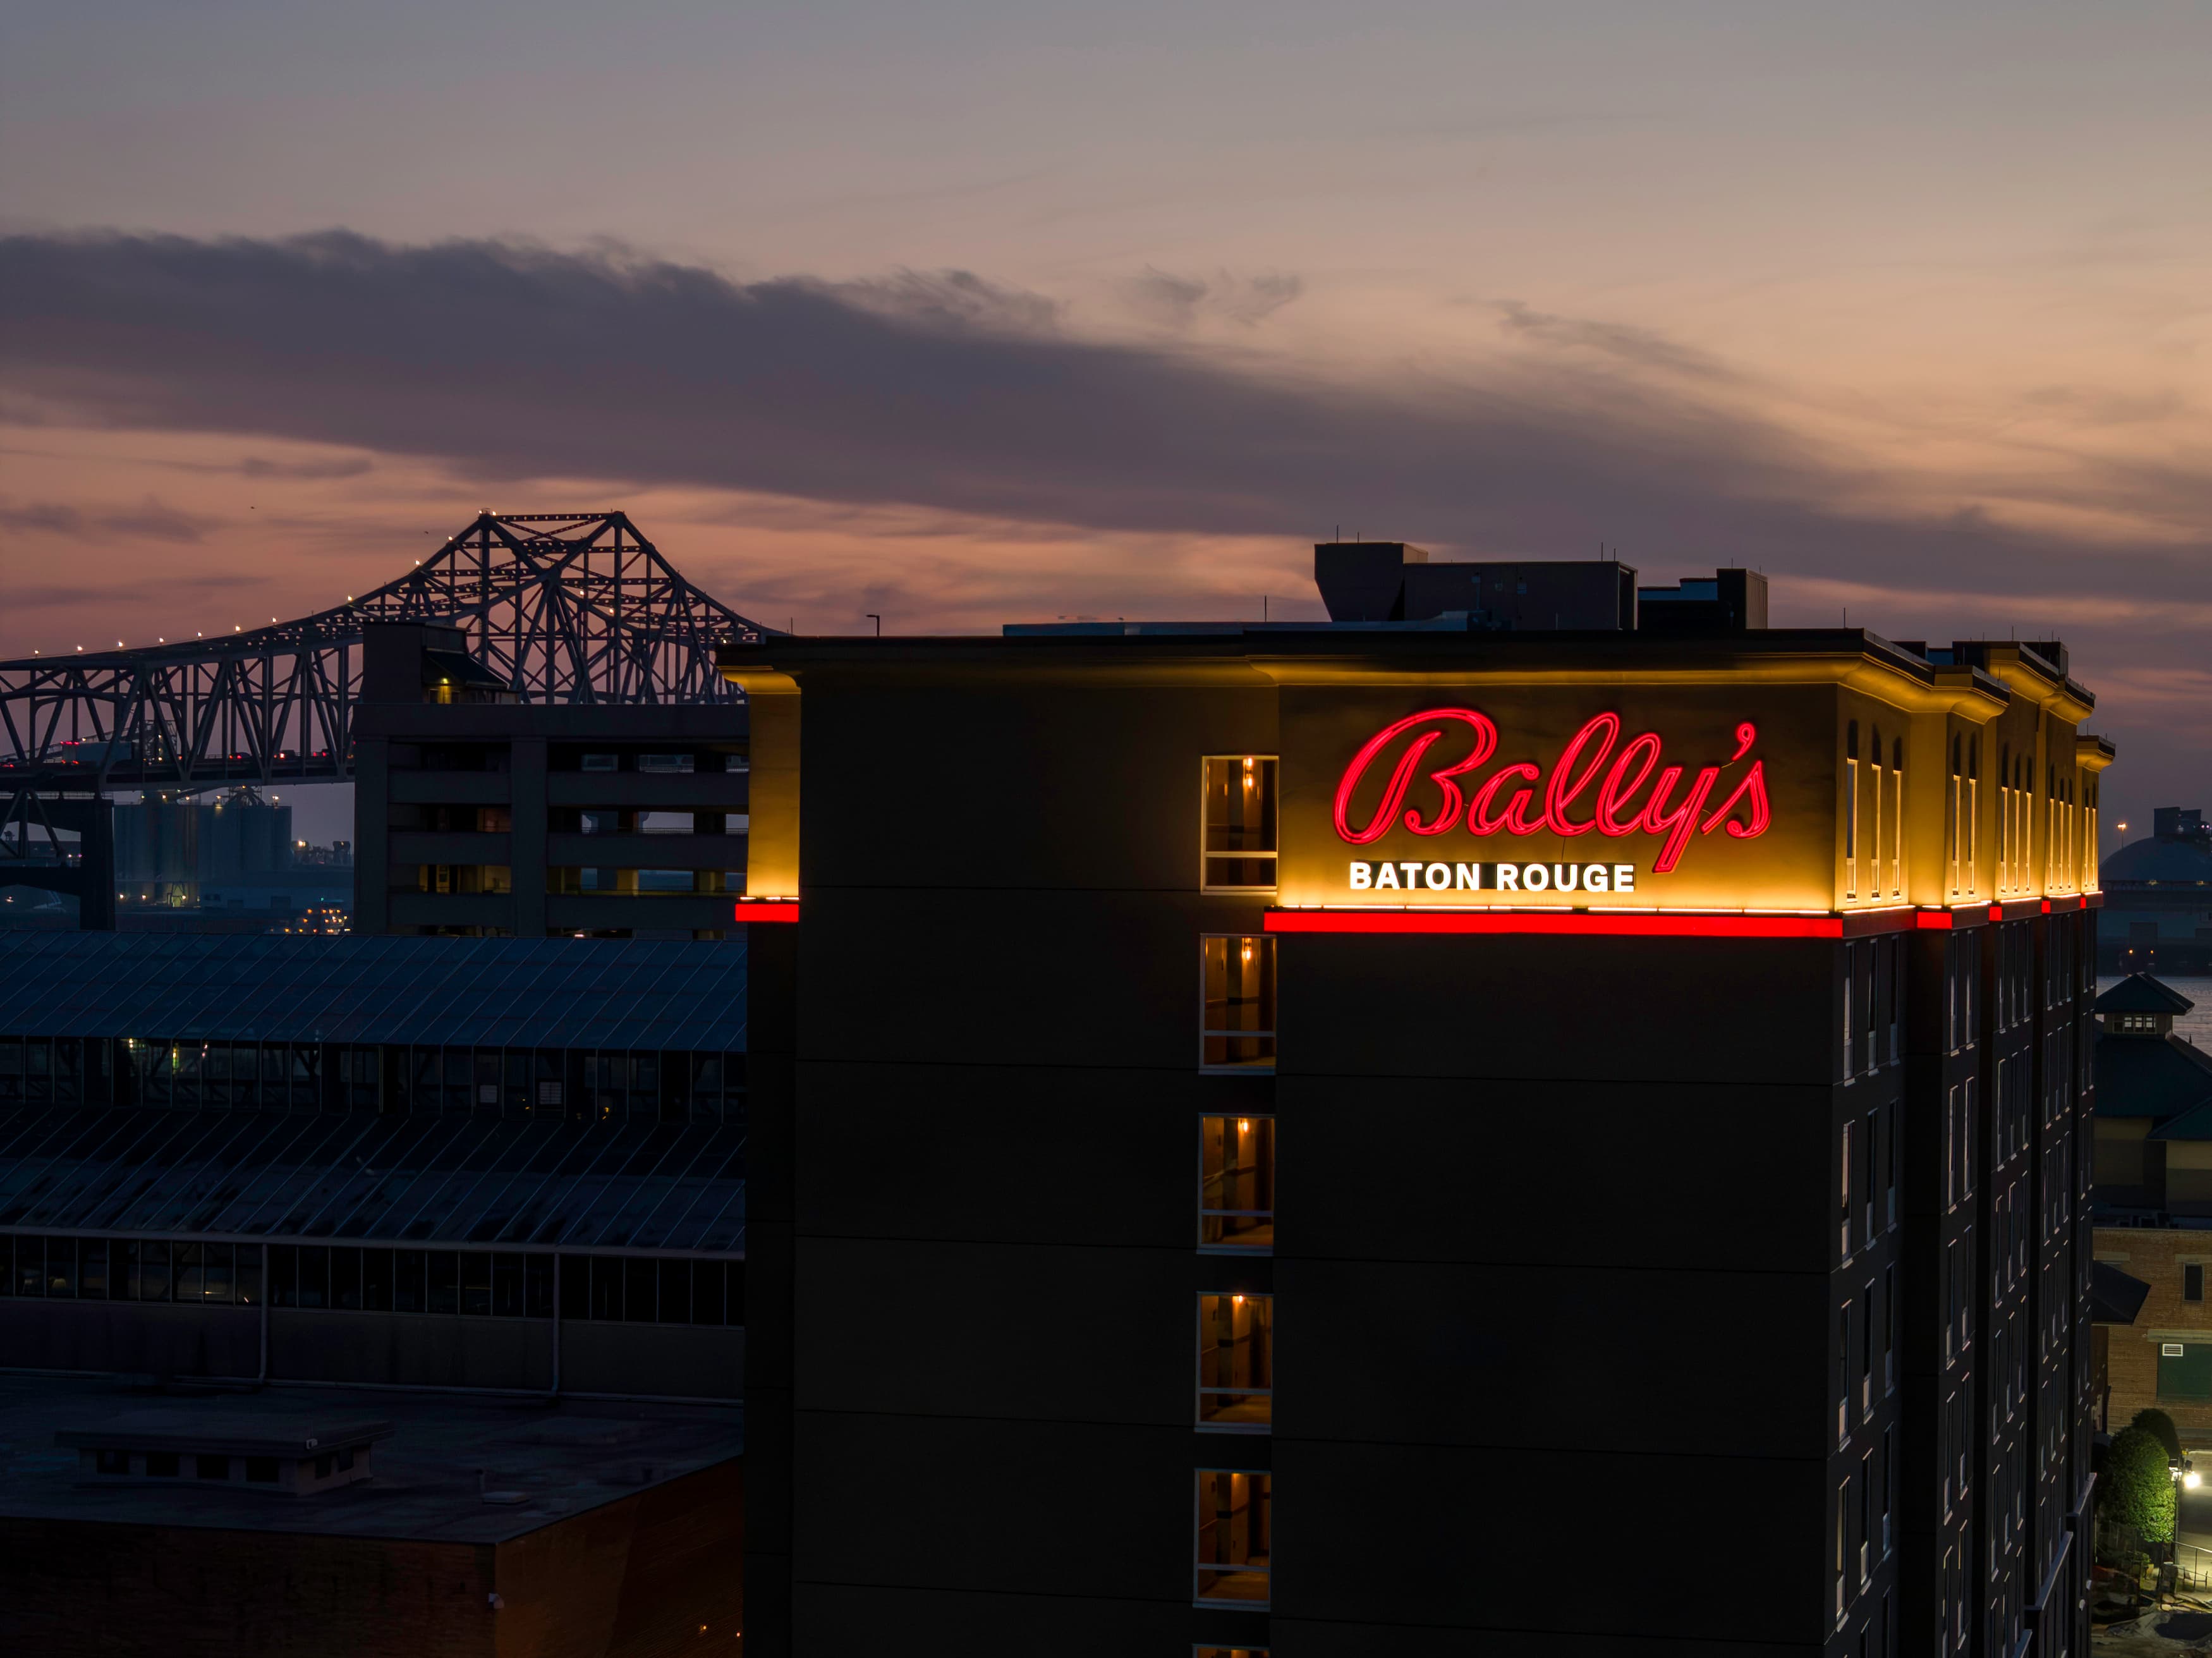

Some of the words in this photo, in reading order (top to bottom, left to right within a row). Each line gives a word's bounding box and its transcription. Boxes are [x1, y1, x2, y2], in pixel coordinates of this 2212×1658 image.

[1332, 707, 1770, 873] Bally's
[1349, 862, 1480, 891] BATON
[1496, 863, 1635, 893] ROUGE
